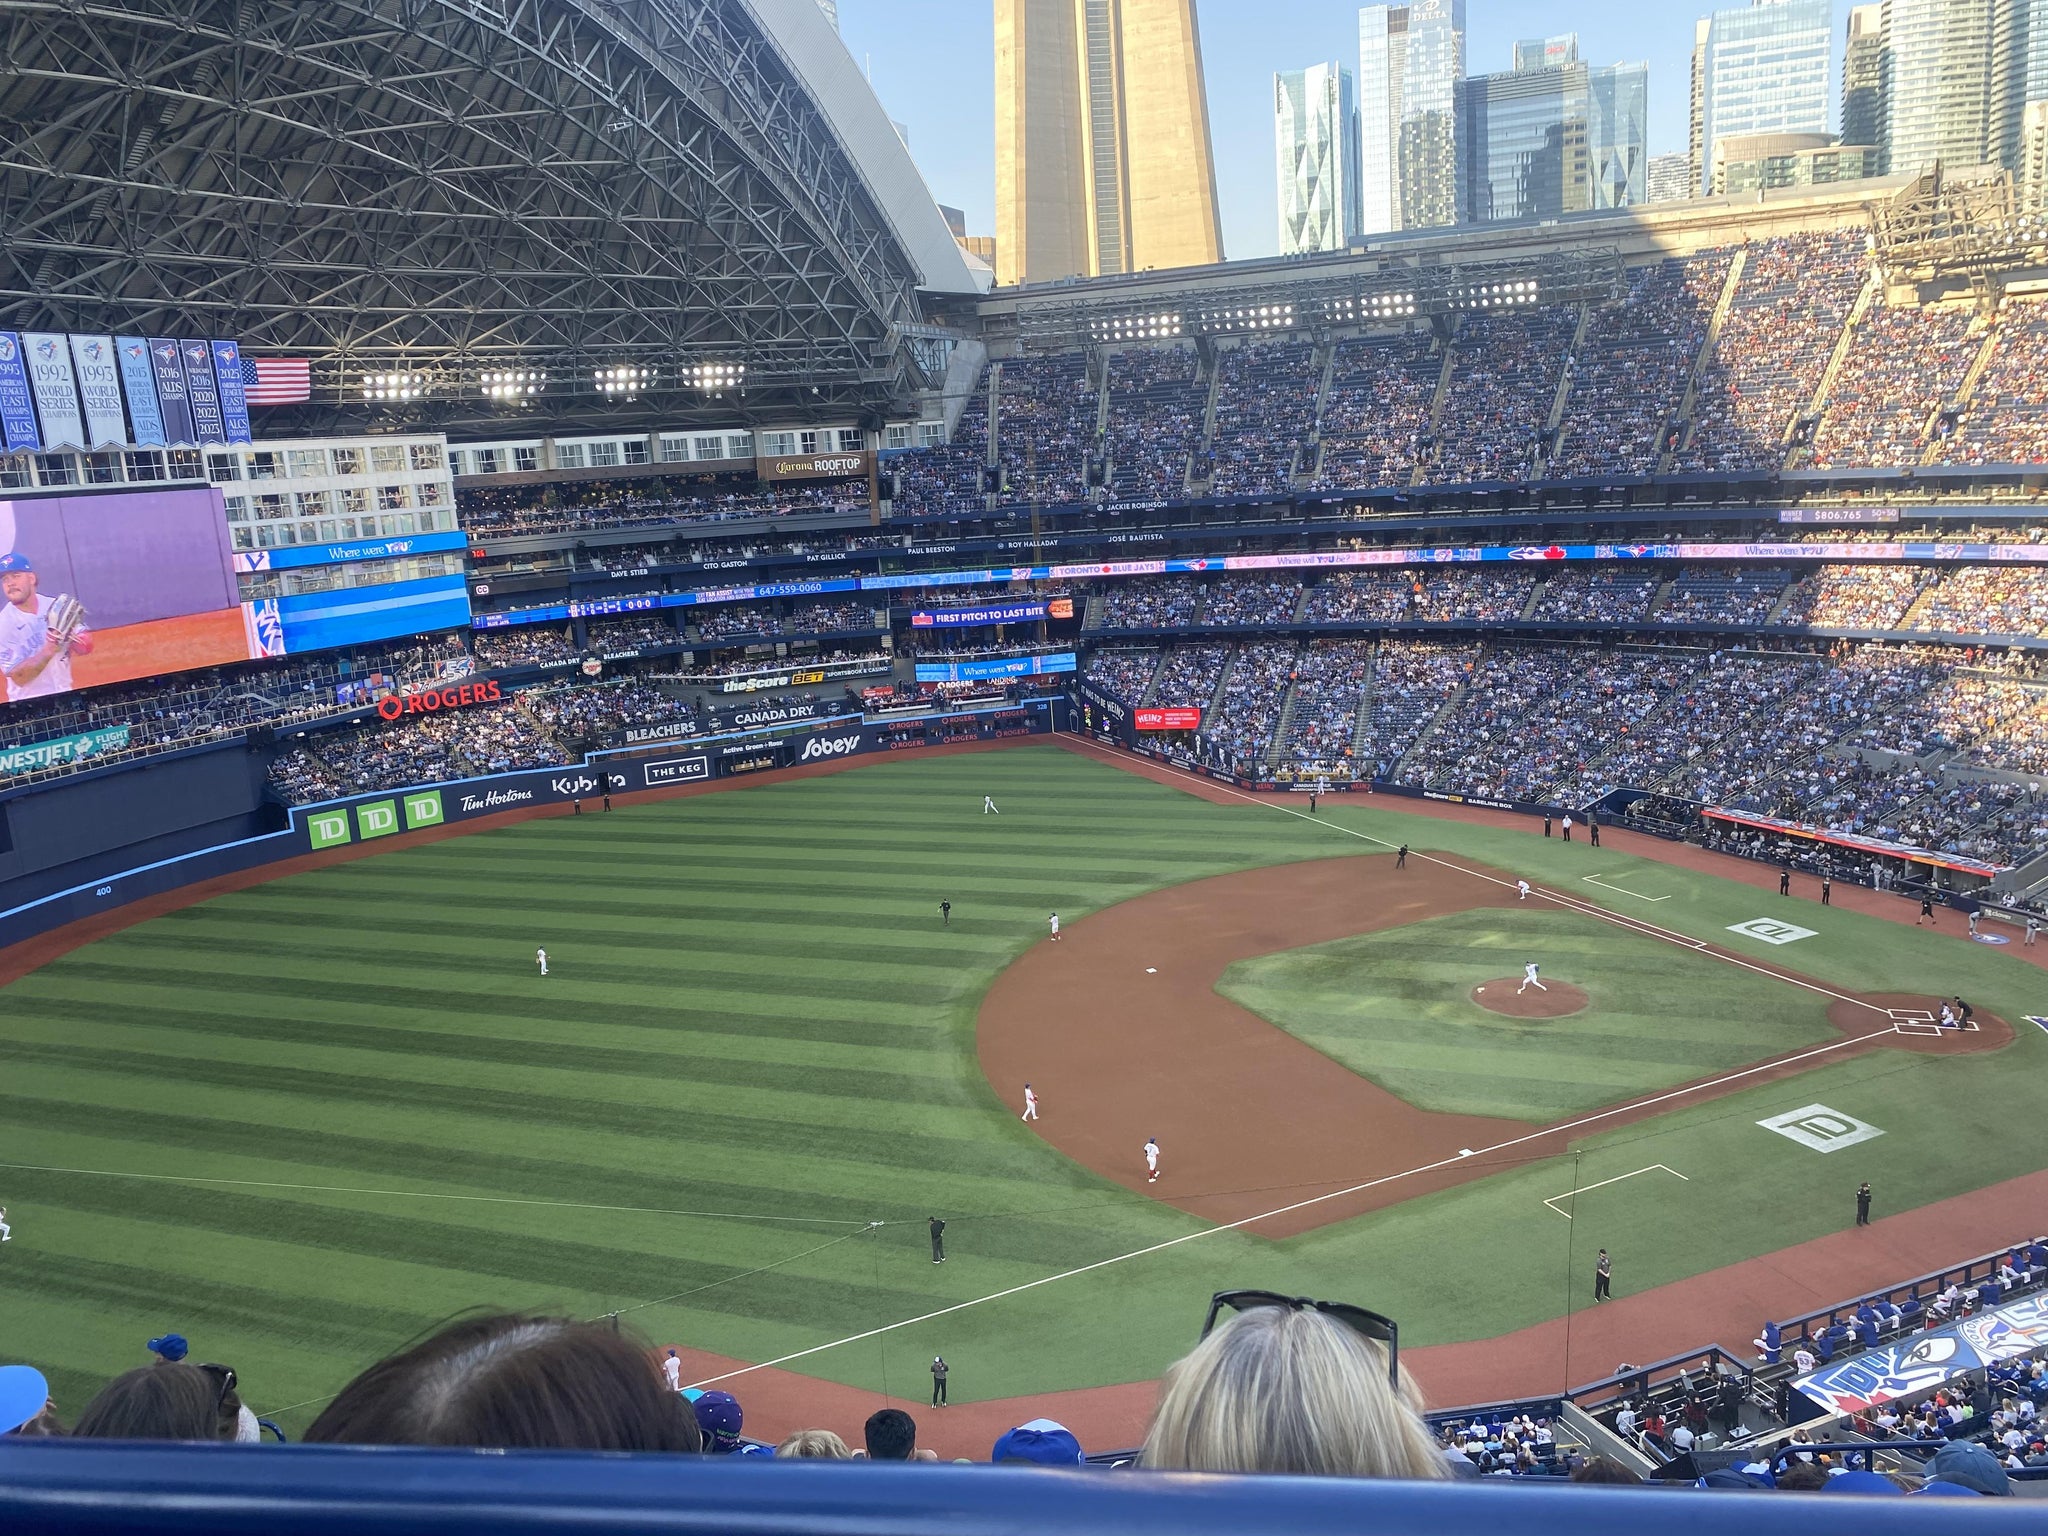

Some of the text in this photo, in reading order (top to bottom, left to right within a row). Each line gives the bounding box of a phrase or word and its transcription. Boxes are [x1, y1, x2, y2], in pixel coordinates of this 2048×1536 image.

[1413, 11, 1447, 22] DELTA
[0, 363, 20, 375] 993
[34, 364, 69, 381] 1992
[82, 364, 114, 381] 1993
[127, 367, 147, 377] 2015
[159, 367, 180, 378] 2016
[220, 368, 240, 379] 2025
[191, 375, 211, 385] 2016
[38, 385, 73, 397] WORLD
[84, 385, 118, 397] WORLD
[193, 391, 215, 402] 2020
[2, 395, 26, 406] EAST
[40, 398, 75, 409] SERIES
[87, 398, 120, 409] SERIES
[132, 397, 153, 406] EAST
[224, 397, 244, 406] EAST
[197, 407, 217, 418] 2022
[9, 421, 33, 433] ALCS
[228, 419, 247, 429] ALCS
[775, 458, 861, 474] Corona ROOFTOP
[1107, 501, 1168, 511] JACKIE ROBINSON
[1108, 533, 1164, 543] JOSÉ BAUTISTA
[1008, 540, 1058, 549] ROY HALLADAY
[328, 547, 360, 559] Where
[362, 547, 385, 556] were
[907, 546, 956, 555] PAUL BEESTON
[1744, 546, 1774, 555] Where
[1777, 547, 1798, 555] were
[806, 553, 846, 562] PAT GILLICK
[1277, 557, 1300, 565] Where
[703, 560, 748, 570] CITO GASTON
[1060, 563, 1155, 575] TORONTO BLUE JAYS
[611, 568, 648, 578] DAVE STIEB
[759, 584, 822, 596] 647-559-0060
[936, 614, 962, 623] FIRST
[963, 612, 989, 622] PITCH
[990, 611, 1001, 619] TO
[1003, 609, 1024, 618] LAST
[1026, 607, 1044, 616] BITE
[603, 650, 639, 660] BLEACHERS
[540, 657, 580, 669] CANADA DRY
[963, 666, 988, 676] Where
[989, 666, 1005, 674] were
[723, 676, 788, 693] theScore
[793, 672, 823, 683] BET
[945, 680, 974, 689] ROGERS
[407, 680, 501, 714] ROGERS
[1001, 709, 1029, 717] ROGERS
[1106, 700, 1125, 720] HEINZ
[735, 709, 787, 725] CANADA
[949, 715, 976, 723] ROGERS
[1137, 713, 1163, 723] HEINZ
[896, 720, 924, 729] ROGERS
[95, 730, 129, 744] FLIGHT
[626, 721, 696, 742] BLEACHERS
[1003, 728, 1030, 737] ROGERS
[898, 740, 925, 748] ROGERS
[951, 734, 978, 743] ROGERS
[723, 746, 743, 754] Active
[801, 735, 860, 760] Sobeys
[652, 763, 701, 777] THE KEG
[460, 788, 532, 812] Tim Hortons
[1468, 798, 1498, 807] BASELINE
[408, 798, 438, 821] TD
[361, 807, 393, 831] TD
[312, 817, 345, 840] TD
[96, 885, 111, 897] 400
[1777, 1114, 1857, 1141] TD
